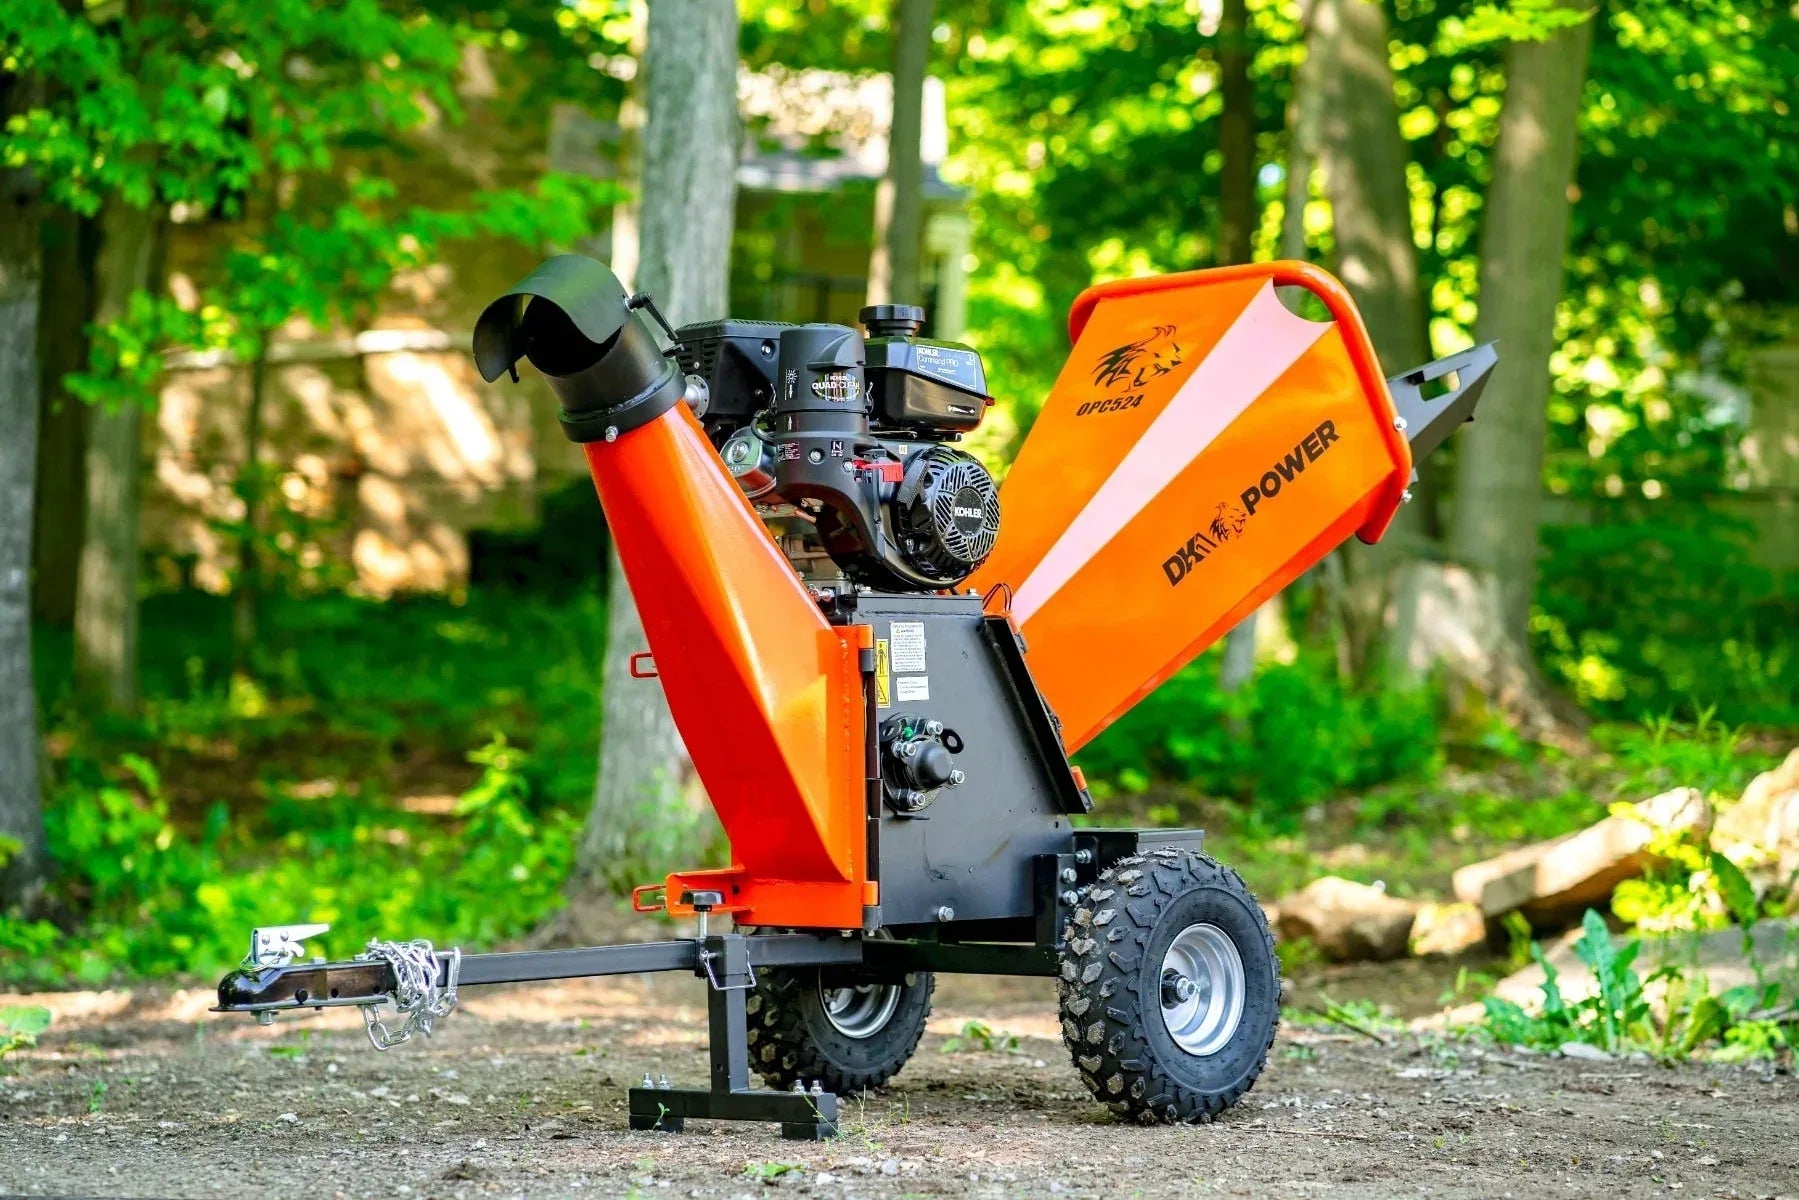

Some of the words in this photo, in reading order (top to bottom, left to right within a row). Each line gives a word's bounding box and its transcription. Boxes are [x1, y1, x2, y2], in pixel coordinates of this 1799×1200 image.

[811, 381, 837, 390] QUAD
[1076, 394, 1144, 416] OPC524
[1240, 419, 1340, 517] POWER
[954, 506, 983, 518] KOHLER
